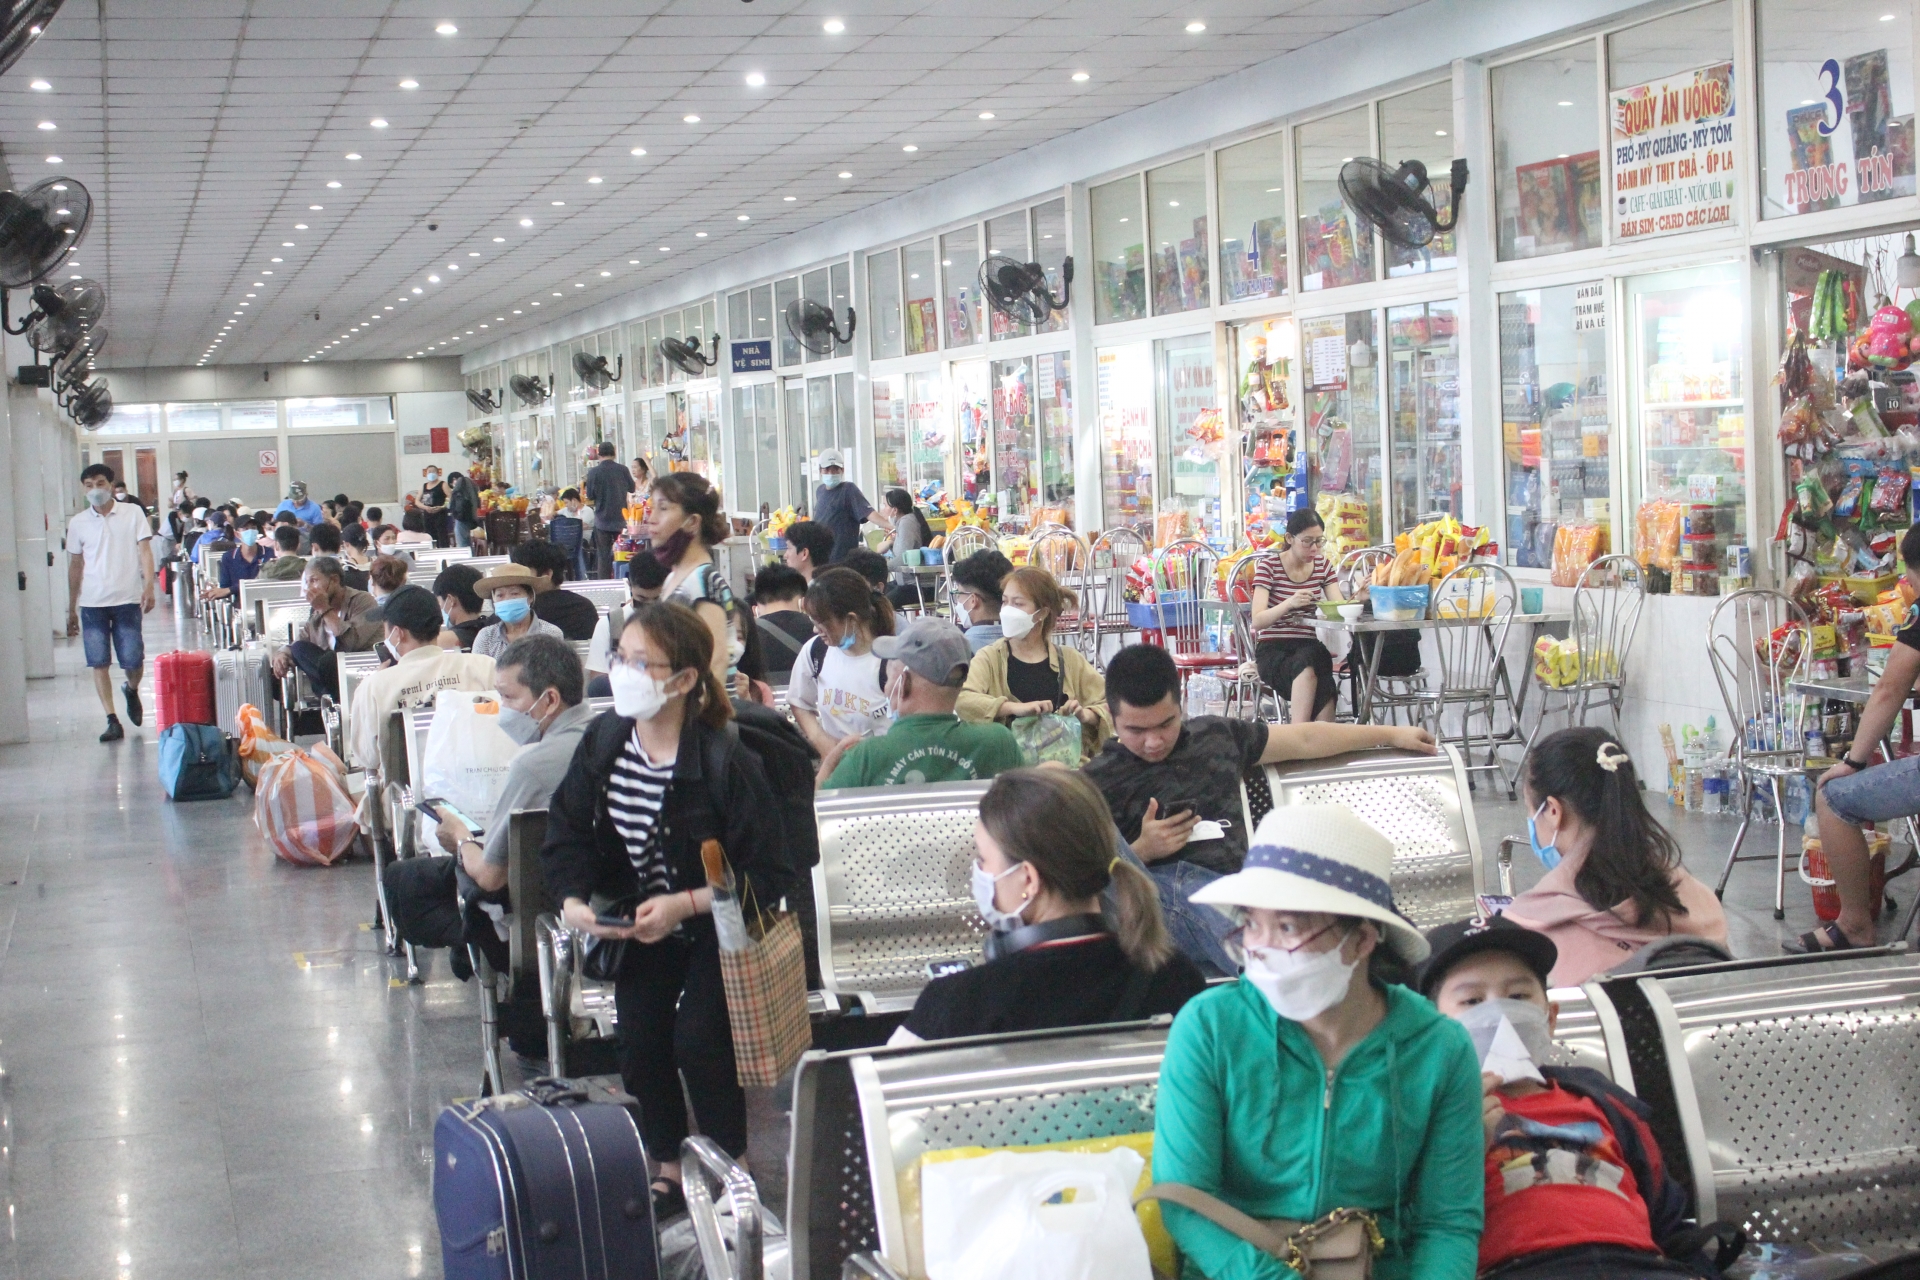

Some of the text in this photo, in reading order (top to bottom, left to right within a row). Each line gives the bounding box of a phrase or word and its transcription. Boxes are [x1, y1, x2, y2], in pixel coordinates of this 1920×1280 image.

[1624, 73, 1723, 137] QUẦY ĂN UỐNG
[1818, 58, 1843, 136] 3
[1652, 129, 1687, 158] QUẢNG
[1710, 120, 1733, 145] TÔM
[1617, 165, 1638, 192] BÁNH
[1656, 161, 1675, 186] THỊT
[1678, 152, 1698, 180] CHẢ
[1721, 150, 1734, 171] LA
[1784, 145, 1894, 205] TRUNG TÍN
[1620, 204, 1731, 238] BÁN SIM CARD CÁC LOẠI
[1247, 220, 1259, 271] 4
[734, 358, 770, 369] VỆ SINH
[742, 346, 760, 355] NHÀ
[1887, 400, 1899, 409] 10
[425, 673, 461, 692] original
[822, 687, 871, 718] NKE
[890, 756, 908, 778] MÁY
[907, 748, 926, 762] CÁN
[927, 744, 946, 757] TÔN
